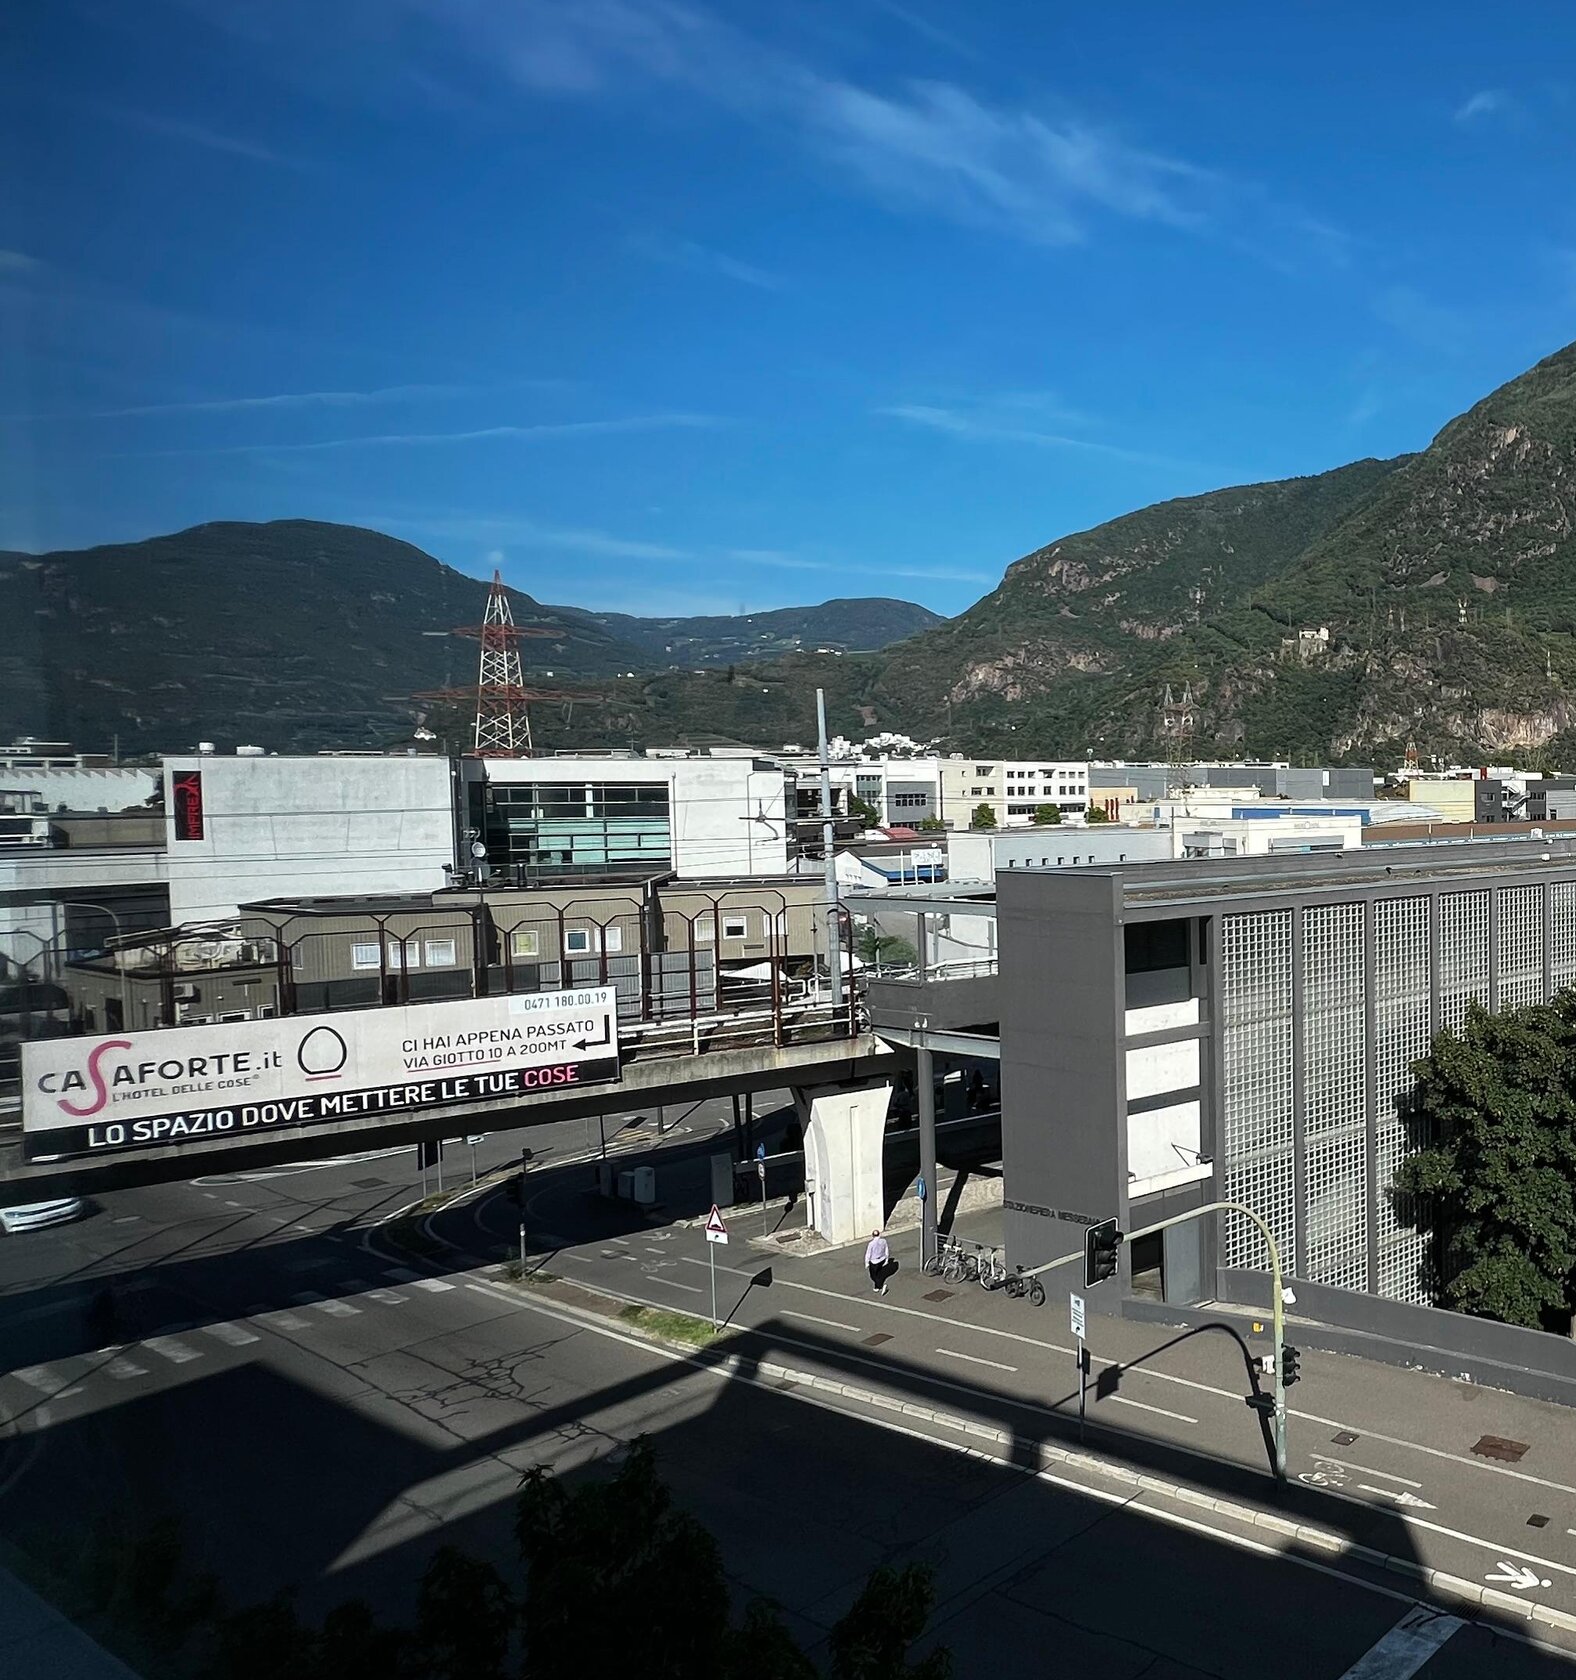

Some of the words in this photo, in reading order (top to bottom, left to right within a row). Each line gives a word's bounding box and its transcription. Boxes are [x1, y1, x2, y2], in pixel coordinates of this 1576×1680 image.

[525, 996, 550, 1011] 0471
[555, 992, 608, 1007] 180.00.19
[402, 1039, 417, 1053] CI
[423, 1035, 450, 1051] HAI
[455, 1028, 522, 1047] APPENA
[527, 1019, 594, 1038] PASSATO
[403, 1054, 429, 1069] VIA
[433, 1049, 485, 1066] GIOTTO
[489, 1047, 503, 1060] 10
[507, 1046, 517, 1057] A
[520, 1040, 567, 1055] 200MT
[88, 1124, 125, 1147] LO
[132, 1110, 234, 1141] SPAZIO
[242, 1099, 314, 1126] DOVE
[321, 1083, 435, 1116] METTERE
[442, 1078, 469, 1099] LE
[474, 1072, 520, 1094] TUE
[524, 1065, 579, 1087] COSE
[112, 1086, 168, 1102] L'HOTEL
[172, 1081, 214, 1095] DELLE
